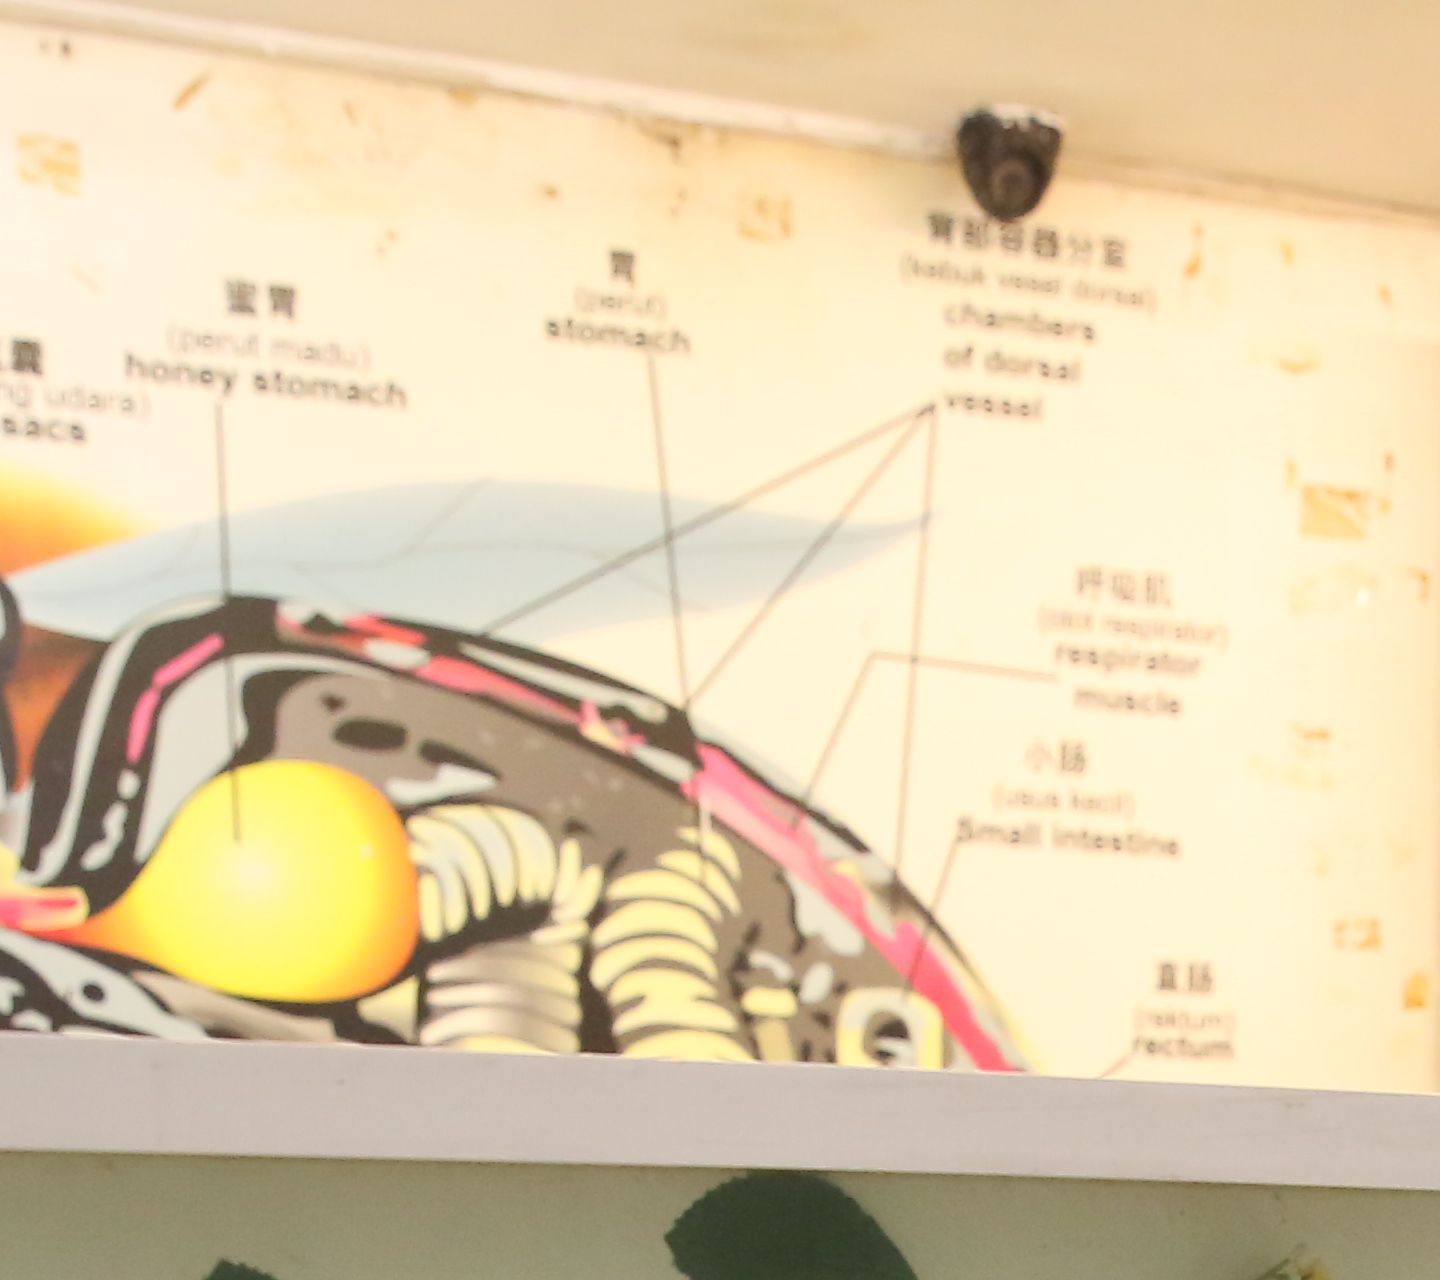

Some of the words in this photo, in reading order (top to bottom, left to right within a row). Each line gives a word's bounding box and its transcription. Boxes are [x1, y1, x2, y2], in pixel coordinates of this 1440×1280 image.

[544, 315, 692, 357] stomach
[943, 301, 1097, 343] chambers
[123, 351, 240, 398] honey
[252, 368, 409, 412] stomach
[942, 345, 976, 371] of
[983, 349, 1082, 384] dorsal
[943, 394, 1044, 420] vessel
[1, 412, 89, 444] sacs
[1054, 643, 1202, 677] respirator
[1073, 686, 1182, 715] muscle
[955, 814, 1042, 848] Small
[1051, 825, 1182, 860] intestine
[1131, 1030, 1236, 1063] rectum
